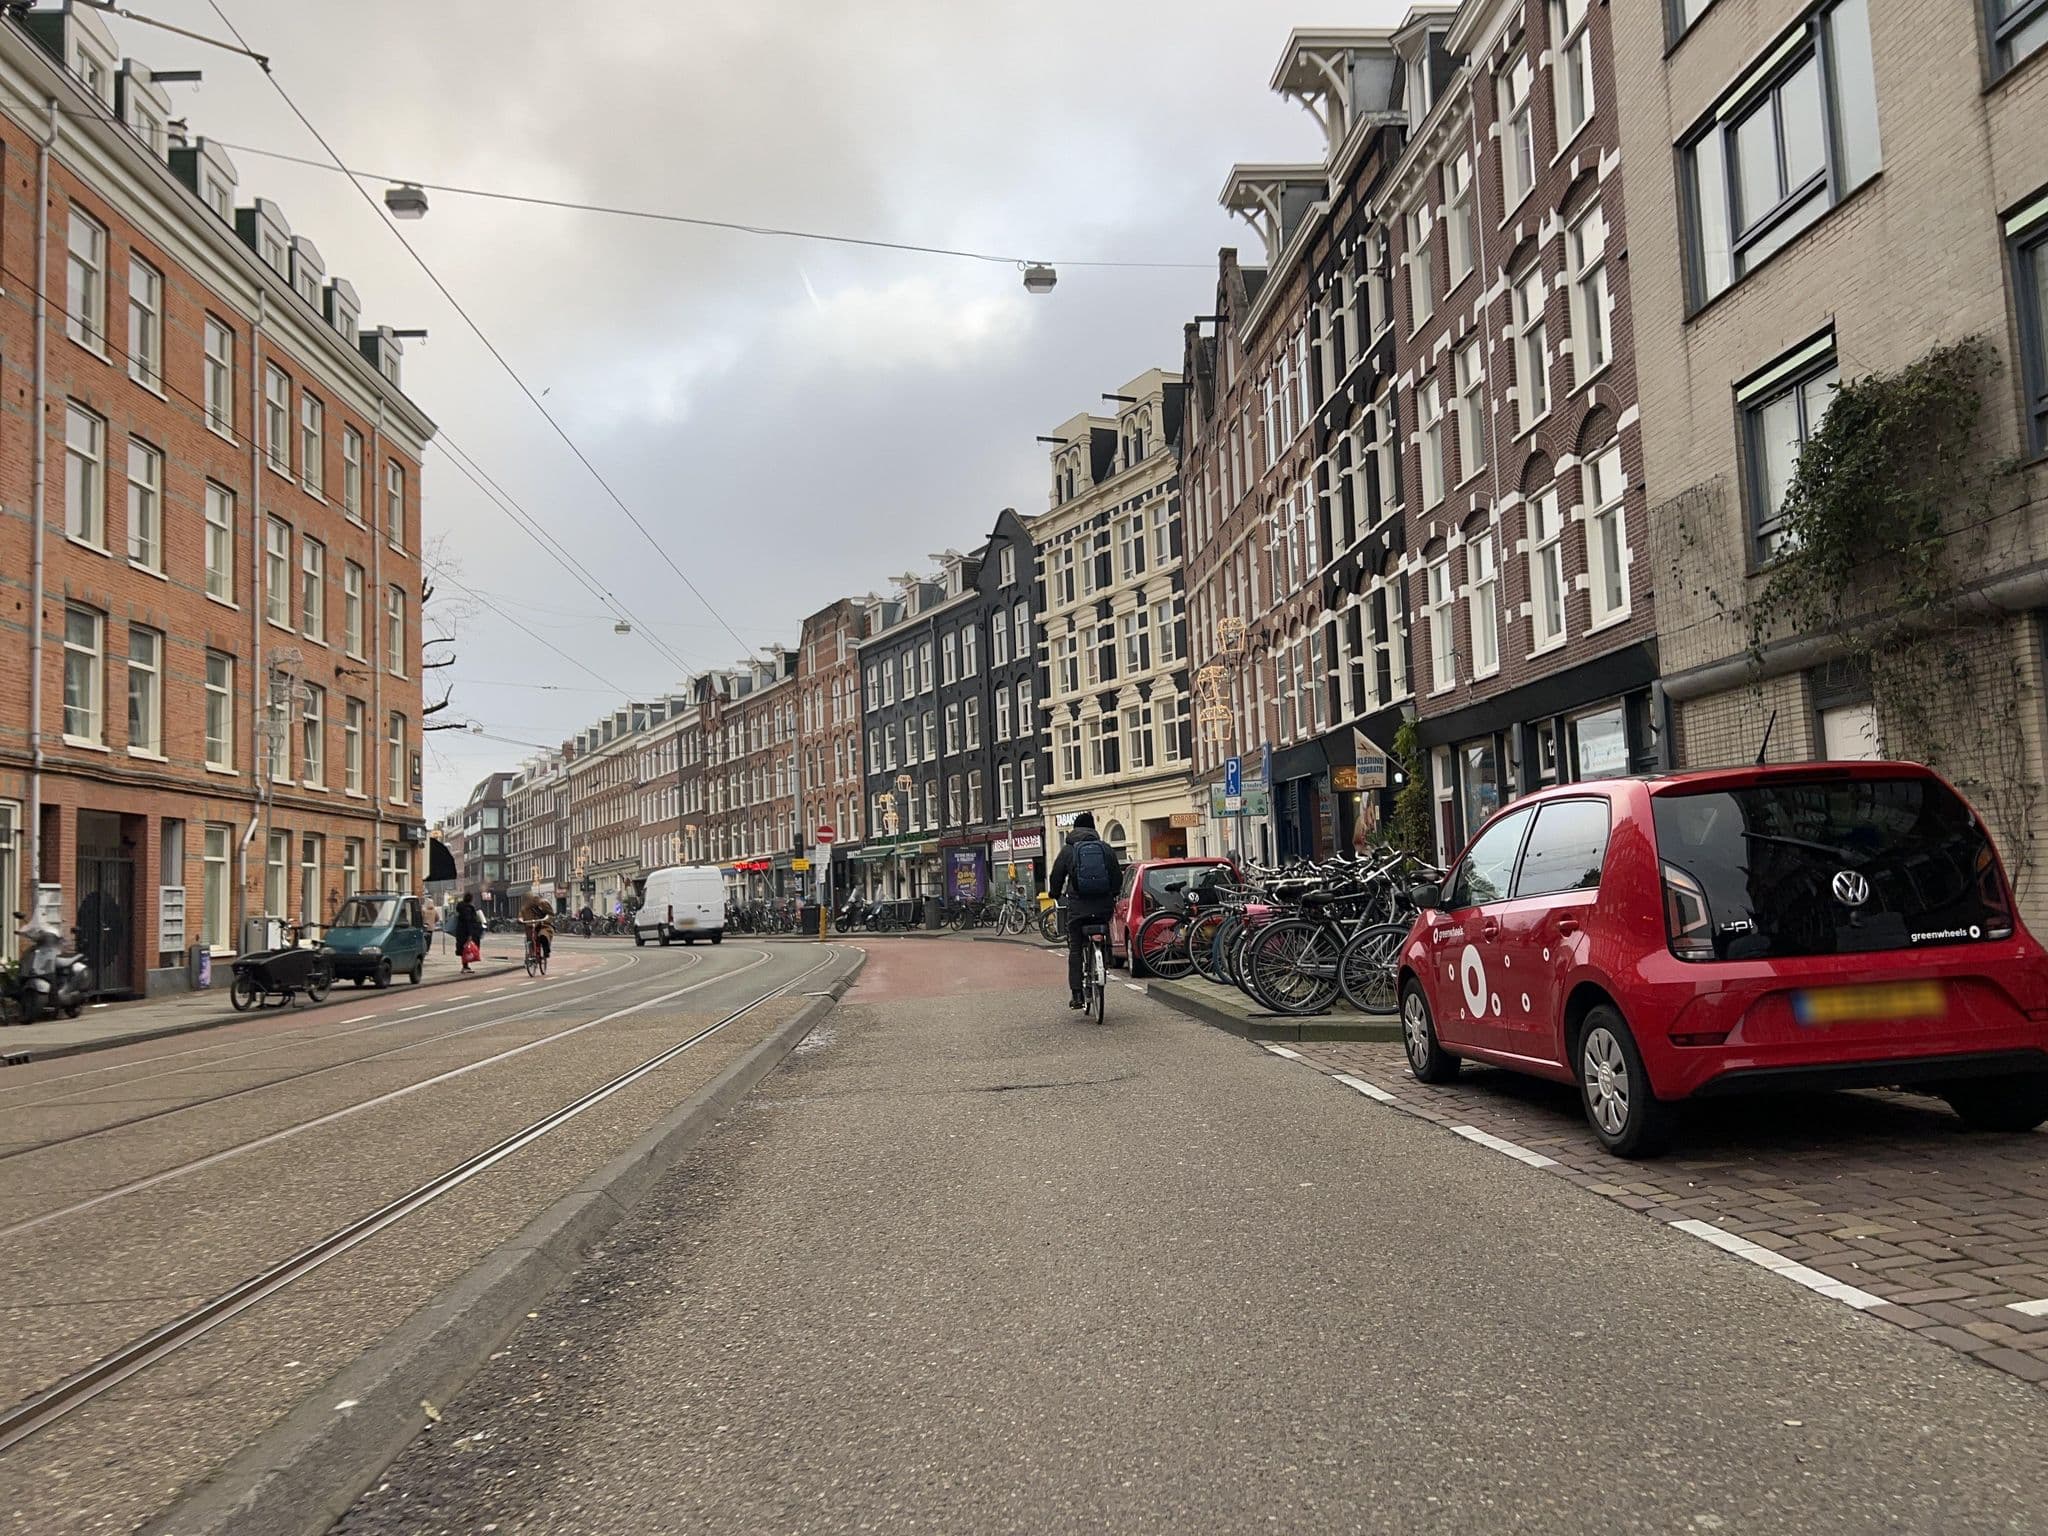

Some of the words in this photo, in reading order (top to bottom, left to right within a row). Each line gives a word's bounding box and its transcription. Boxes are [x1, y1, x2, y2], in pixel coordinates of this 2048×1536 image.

[1357, 756, 1384, 765] KLEDING
[1228, 761, 1237, 780] P
[1720, 919, 1754, 933] up!
[1911, 928, 1968, 943] greenwheels
